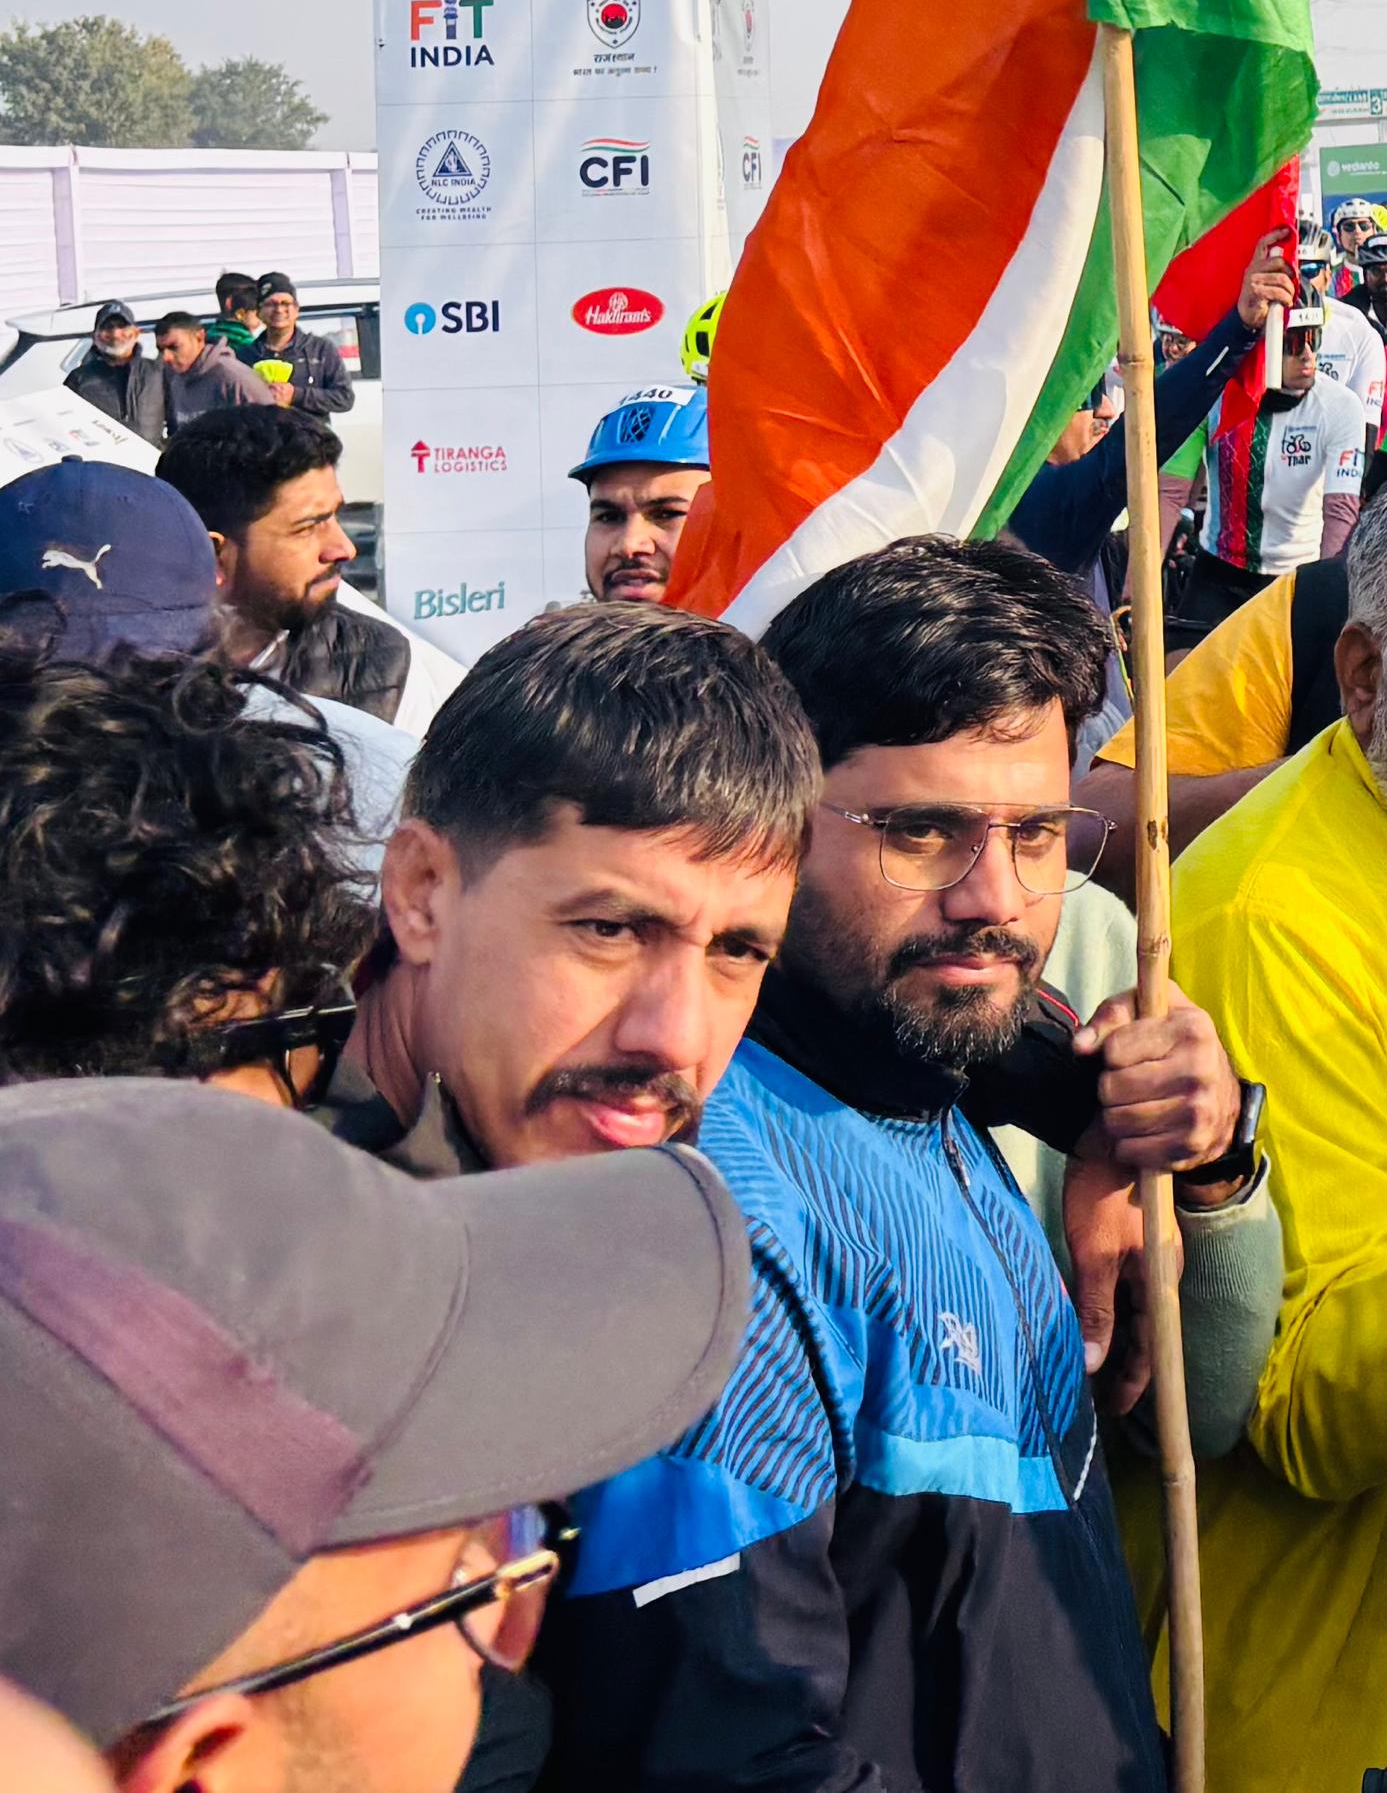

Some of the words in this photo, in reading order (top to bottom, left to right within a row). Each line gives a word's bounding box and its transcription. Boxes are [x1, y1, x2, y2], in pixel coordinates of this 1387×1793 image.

[410, 45, 495, 69] INDIA
[1371, 95, 1382, 114] 3
[580, 155, 649, 188] CFI
[743, 153, 761, 183] CFI
[431, 179, 448, 187] NLC
[451, 178, 476, 186] INDIA
[441, 300, 499, 333] SBI
[434, 446, 506, 460] TIRANGA
[434, 459, 507, 473] LOGISTICS
[414, 581, 505, 620] Bisleri
